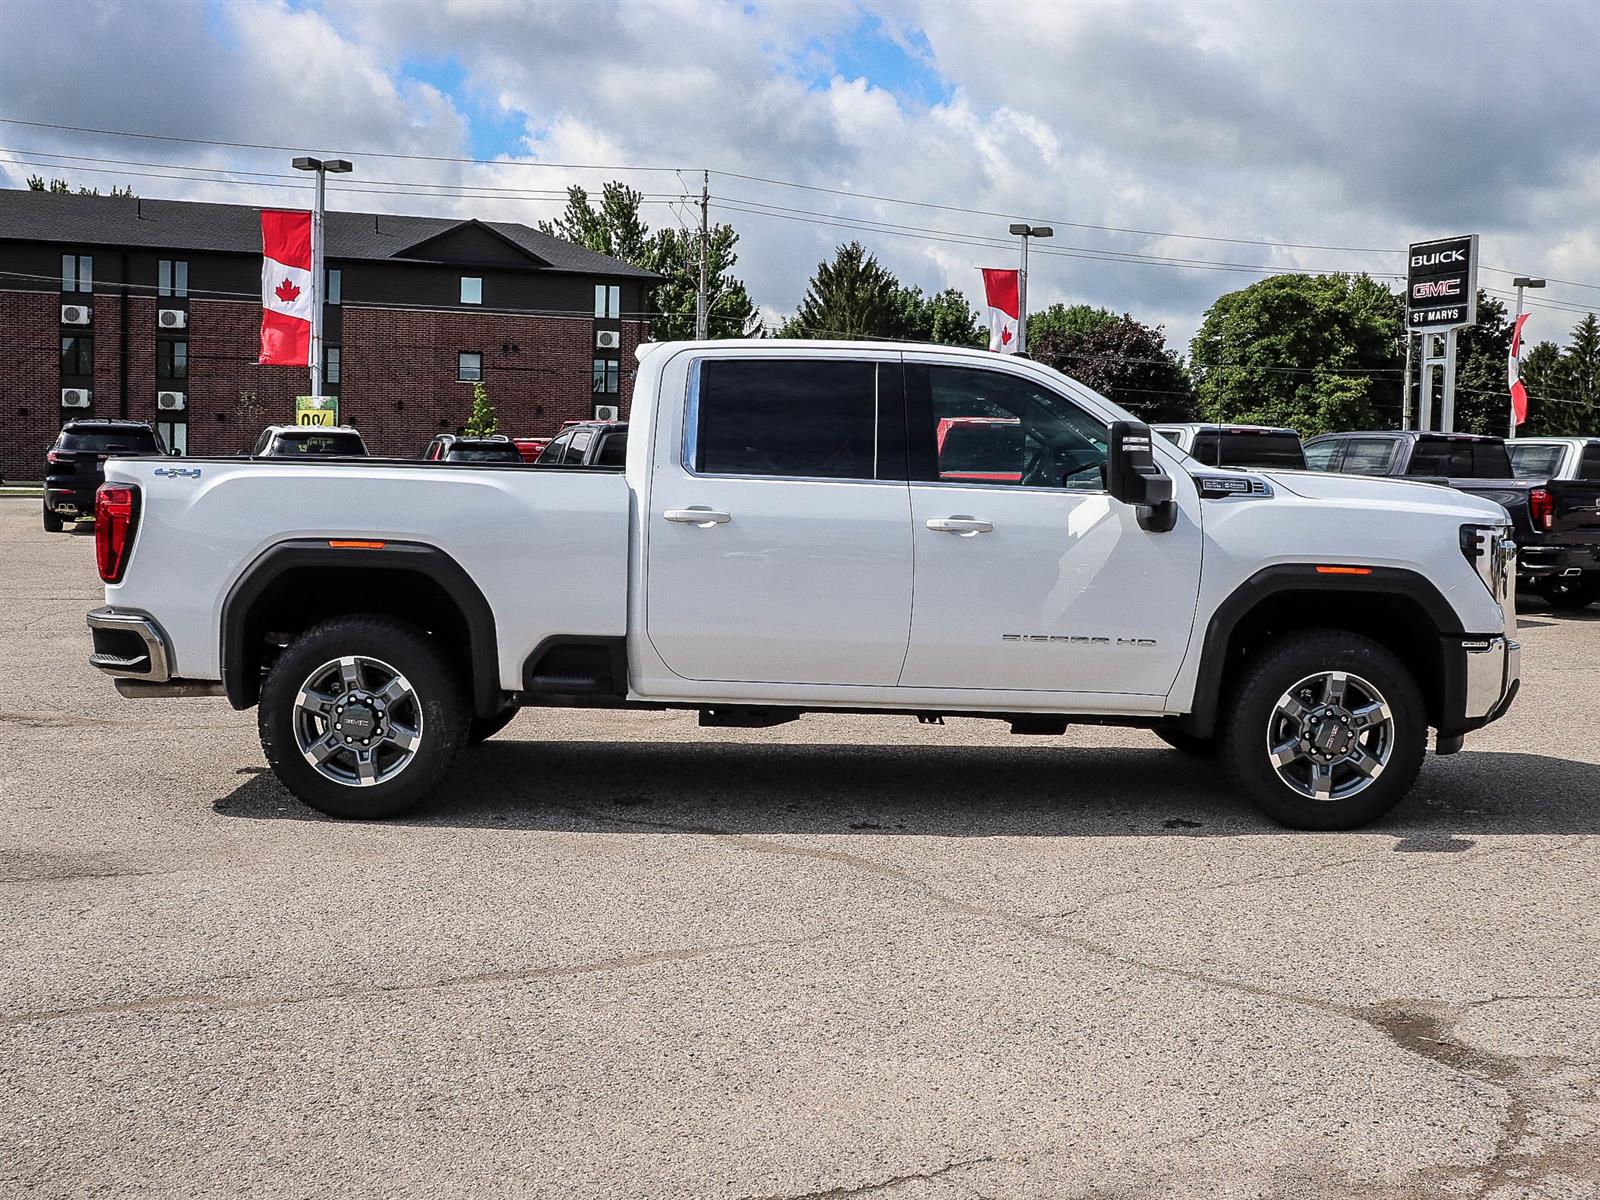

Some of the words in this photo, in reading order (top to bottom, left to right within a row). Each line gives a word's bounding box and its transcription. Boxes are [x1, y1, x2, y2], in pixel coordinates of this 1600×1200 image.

[1411, 249, 1466, 267] BUICK
[1412, 278, 1461, 299] GMC
[1413, 312, 1424, 322] ST
[1428, 309, 1459, 320] MARYS
[1002, 634, 1110, 644] SIERRA
[1117, 638, 1157, 646] HD
